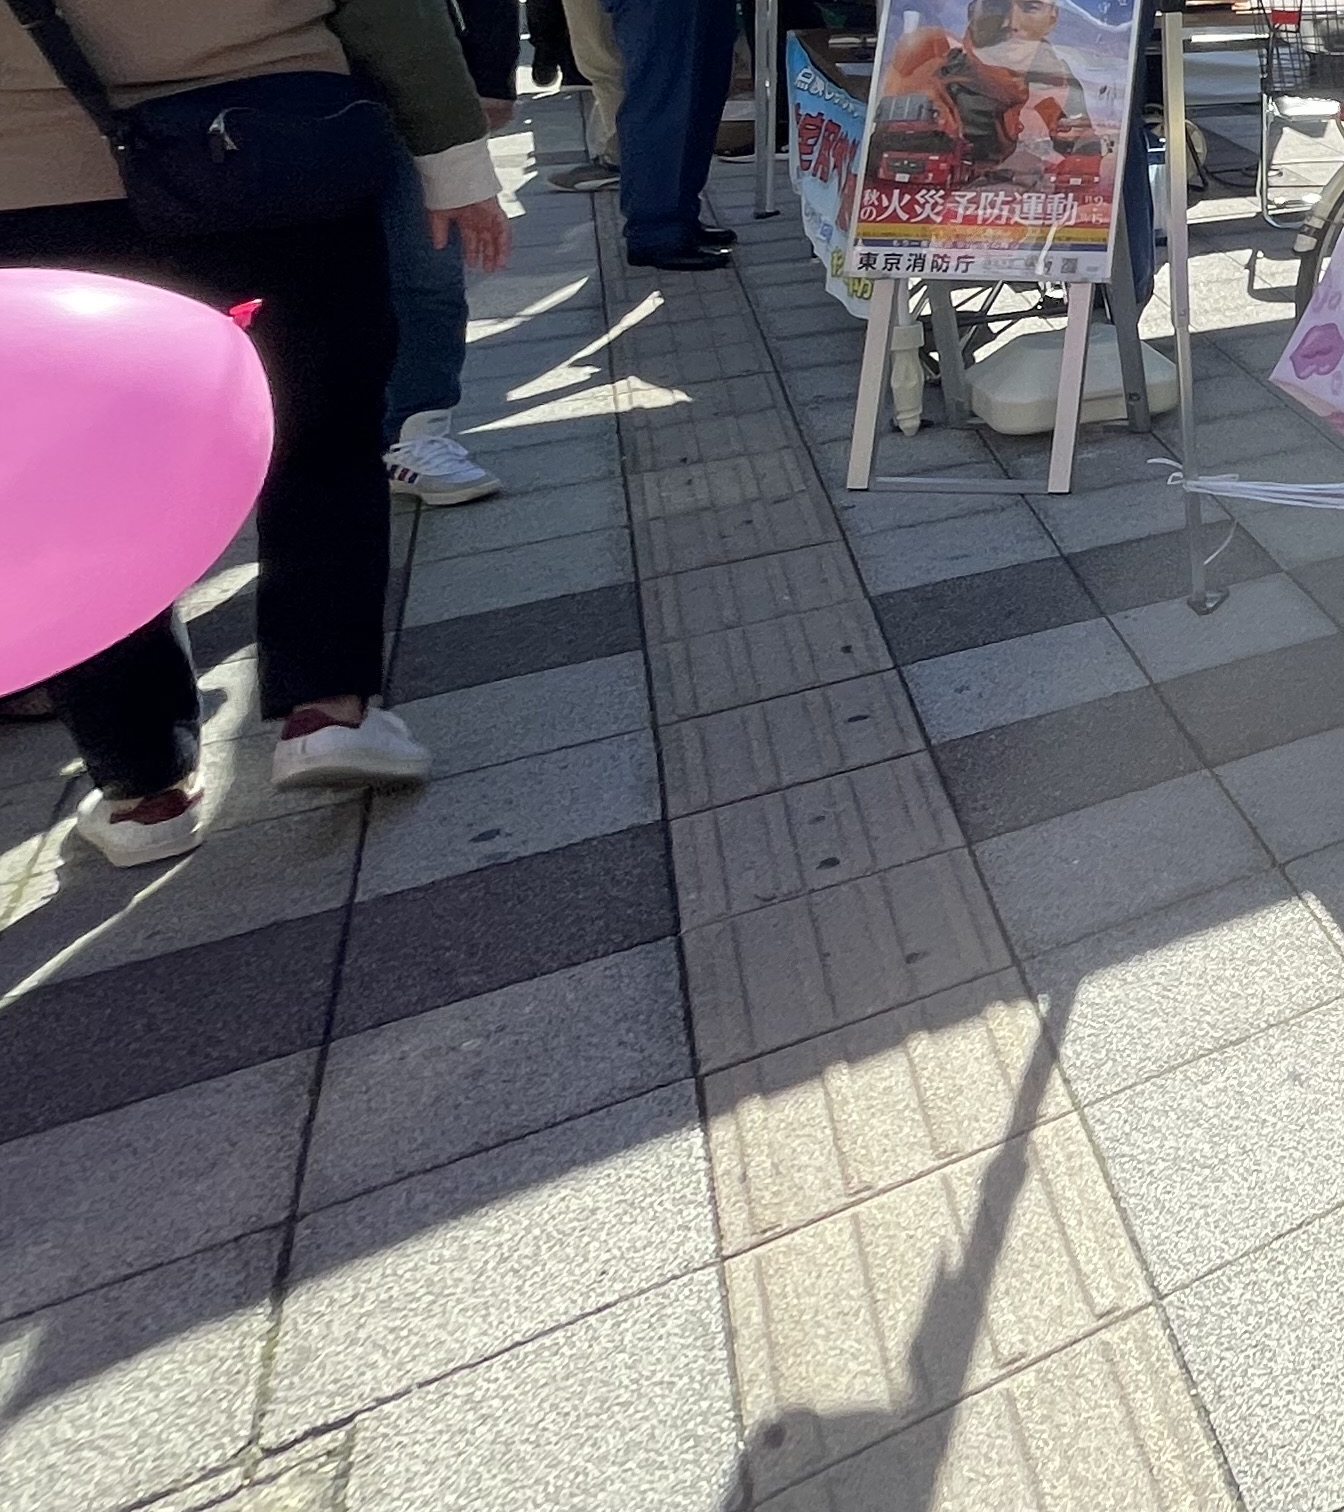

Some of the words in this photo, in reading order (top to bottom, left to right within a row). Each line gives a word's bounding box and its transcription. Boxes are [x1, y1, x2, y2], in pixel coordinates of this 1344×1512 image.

[856, 251, 976, 275] 東京消防庁
